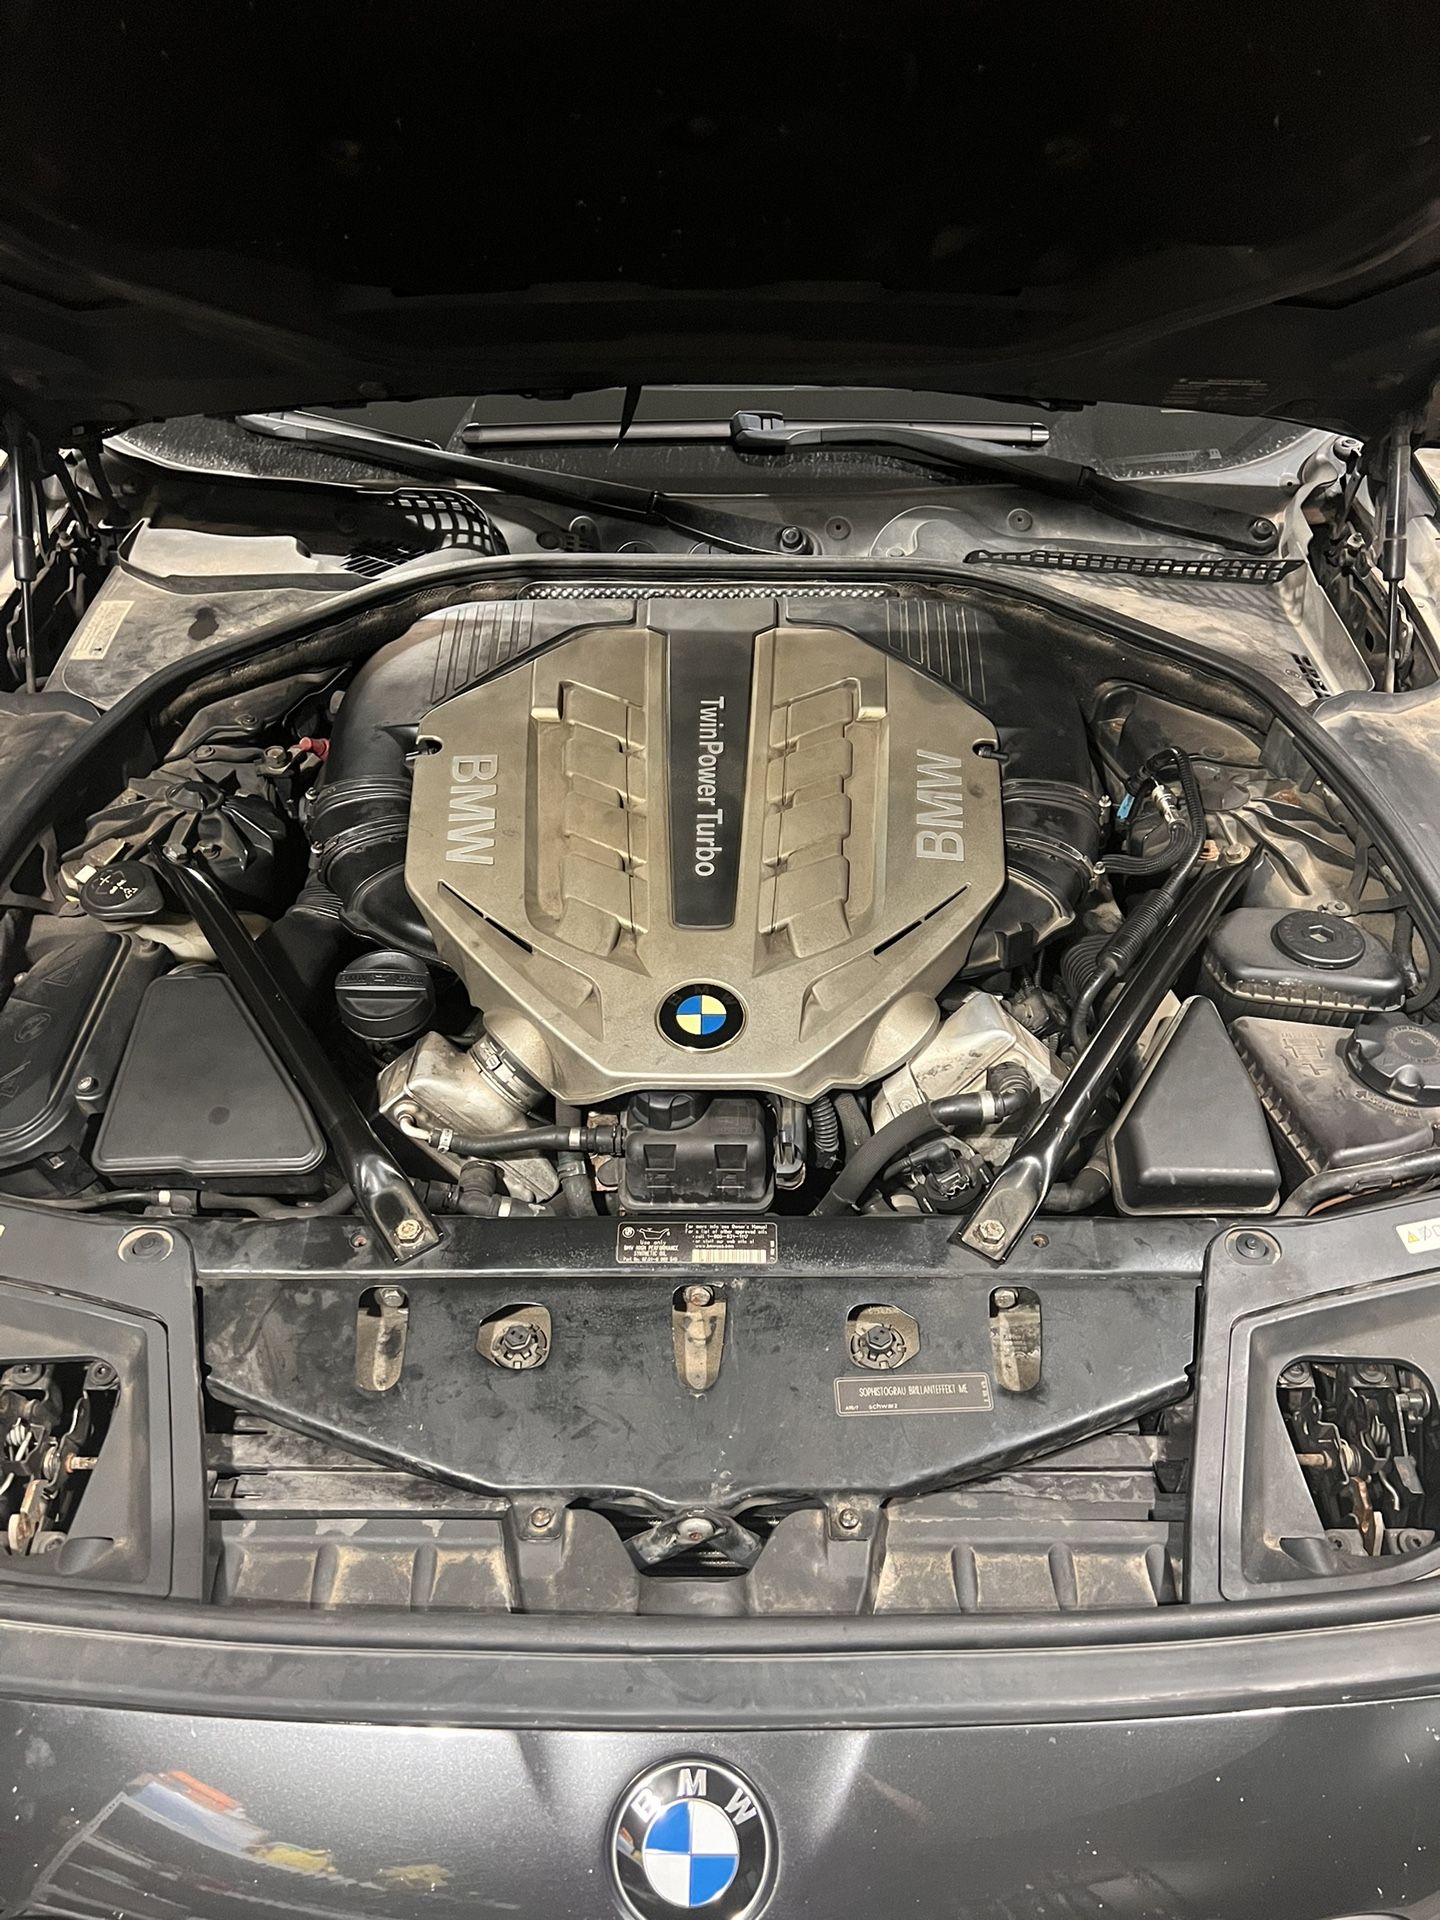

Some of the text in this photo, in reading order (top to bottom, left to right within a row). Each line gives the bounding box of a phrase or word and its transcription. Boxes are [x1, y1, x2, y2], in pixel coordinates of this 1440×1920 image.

[445, 754, 498, 866] BMW
[694, 695, 725, 877] TwinPower Turbo
[916, 748, 965, 862] BMW
[858, 1385, 907, 1397] SOPHISTOGRAU
[908, 1383, 957, 1396] BRILLANTEFFEKT
[630, 1767, 758, 1826] BMW
